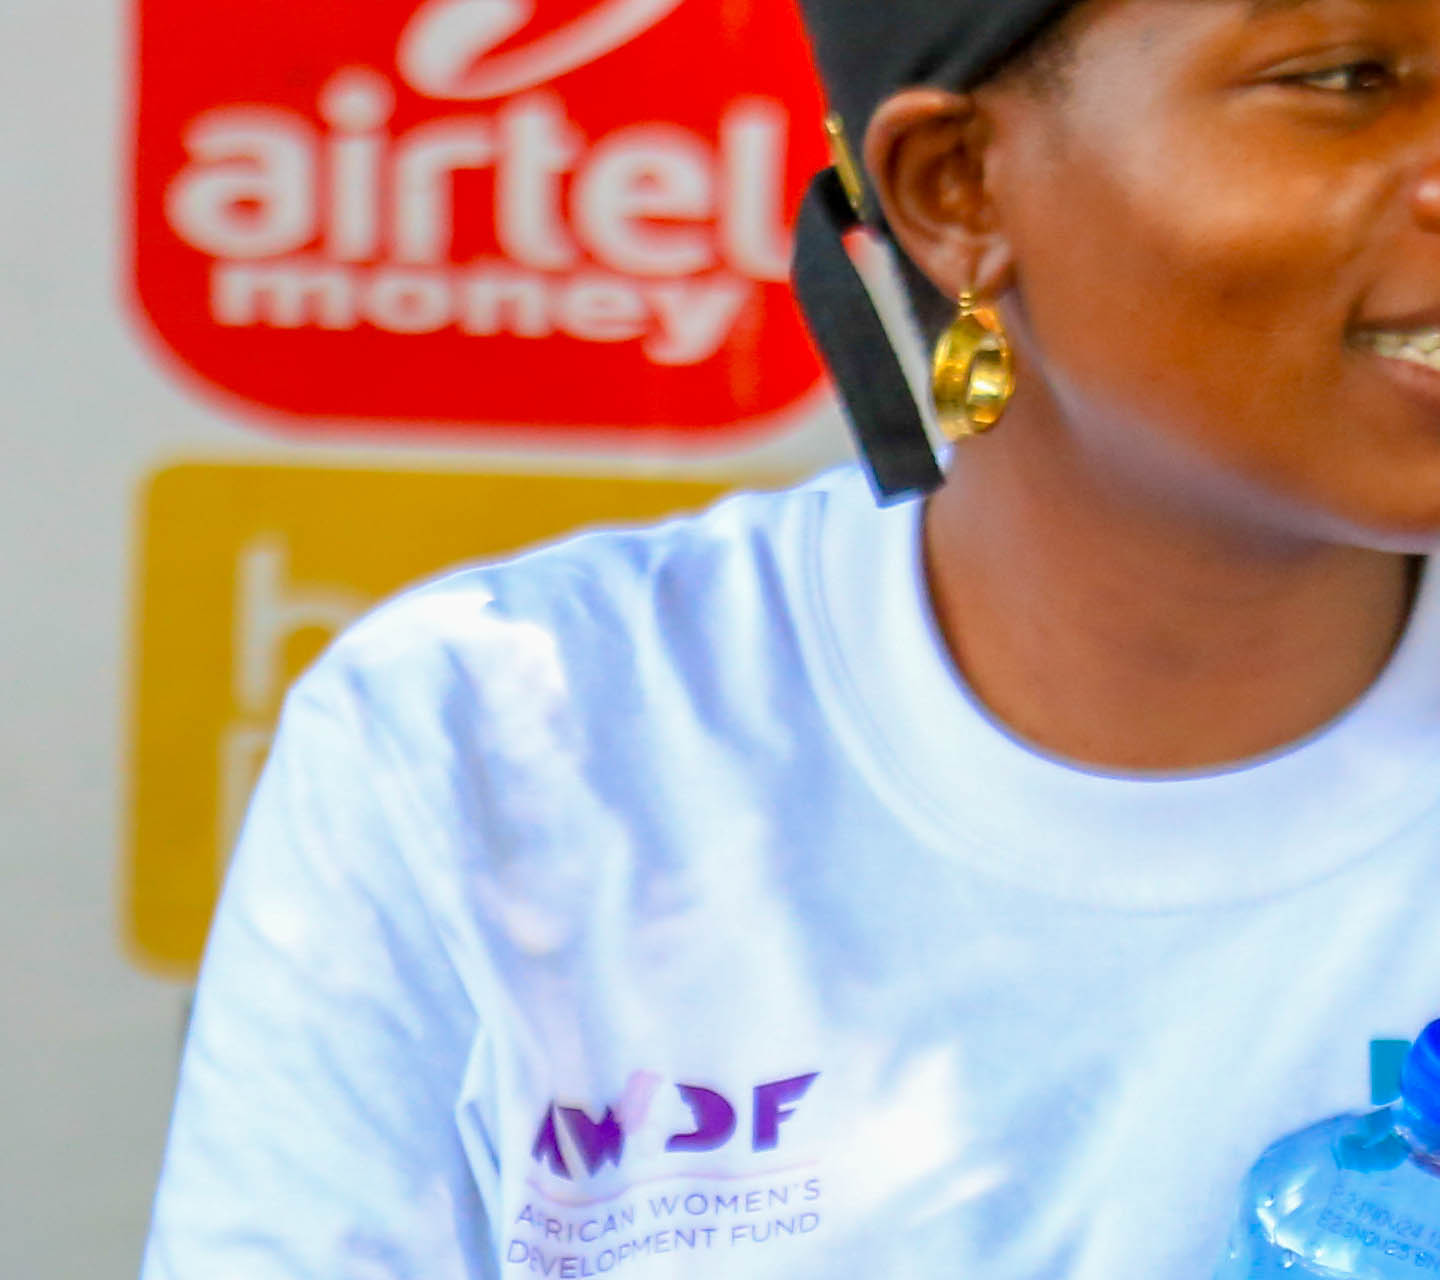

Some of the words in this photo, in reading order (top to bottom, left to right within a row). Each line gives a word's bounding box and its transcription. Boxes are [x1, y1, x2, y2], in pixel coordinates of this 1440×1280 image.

[164, 63, 790, 282] airtel
[208, 260, 745, 366] money
[650, 1178, 821, 1218] WOMEN'S
[731, 1212, 820, 1247] FUND
